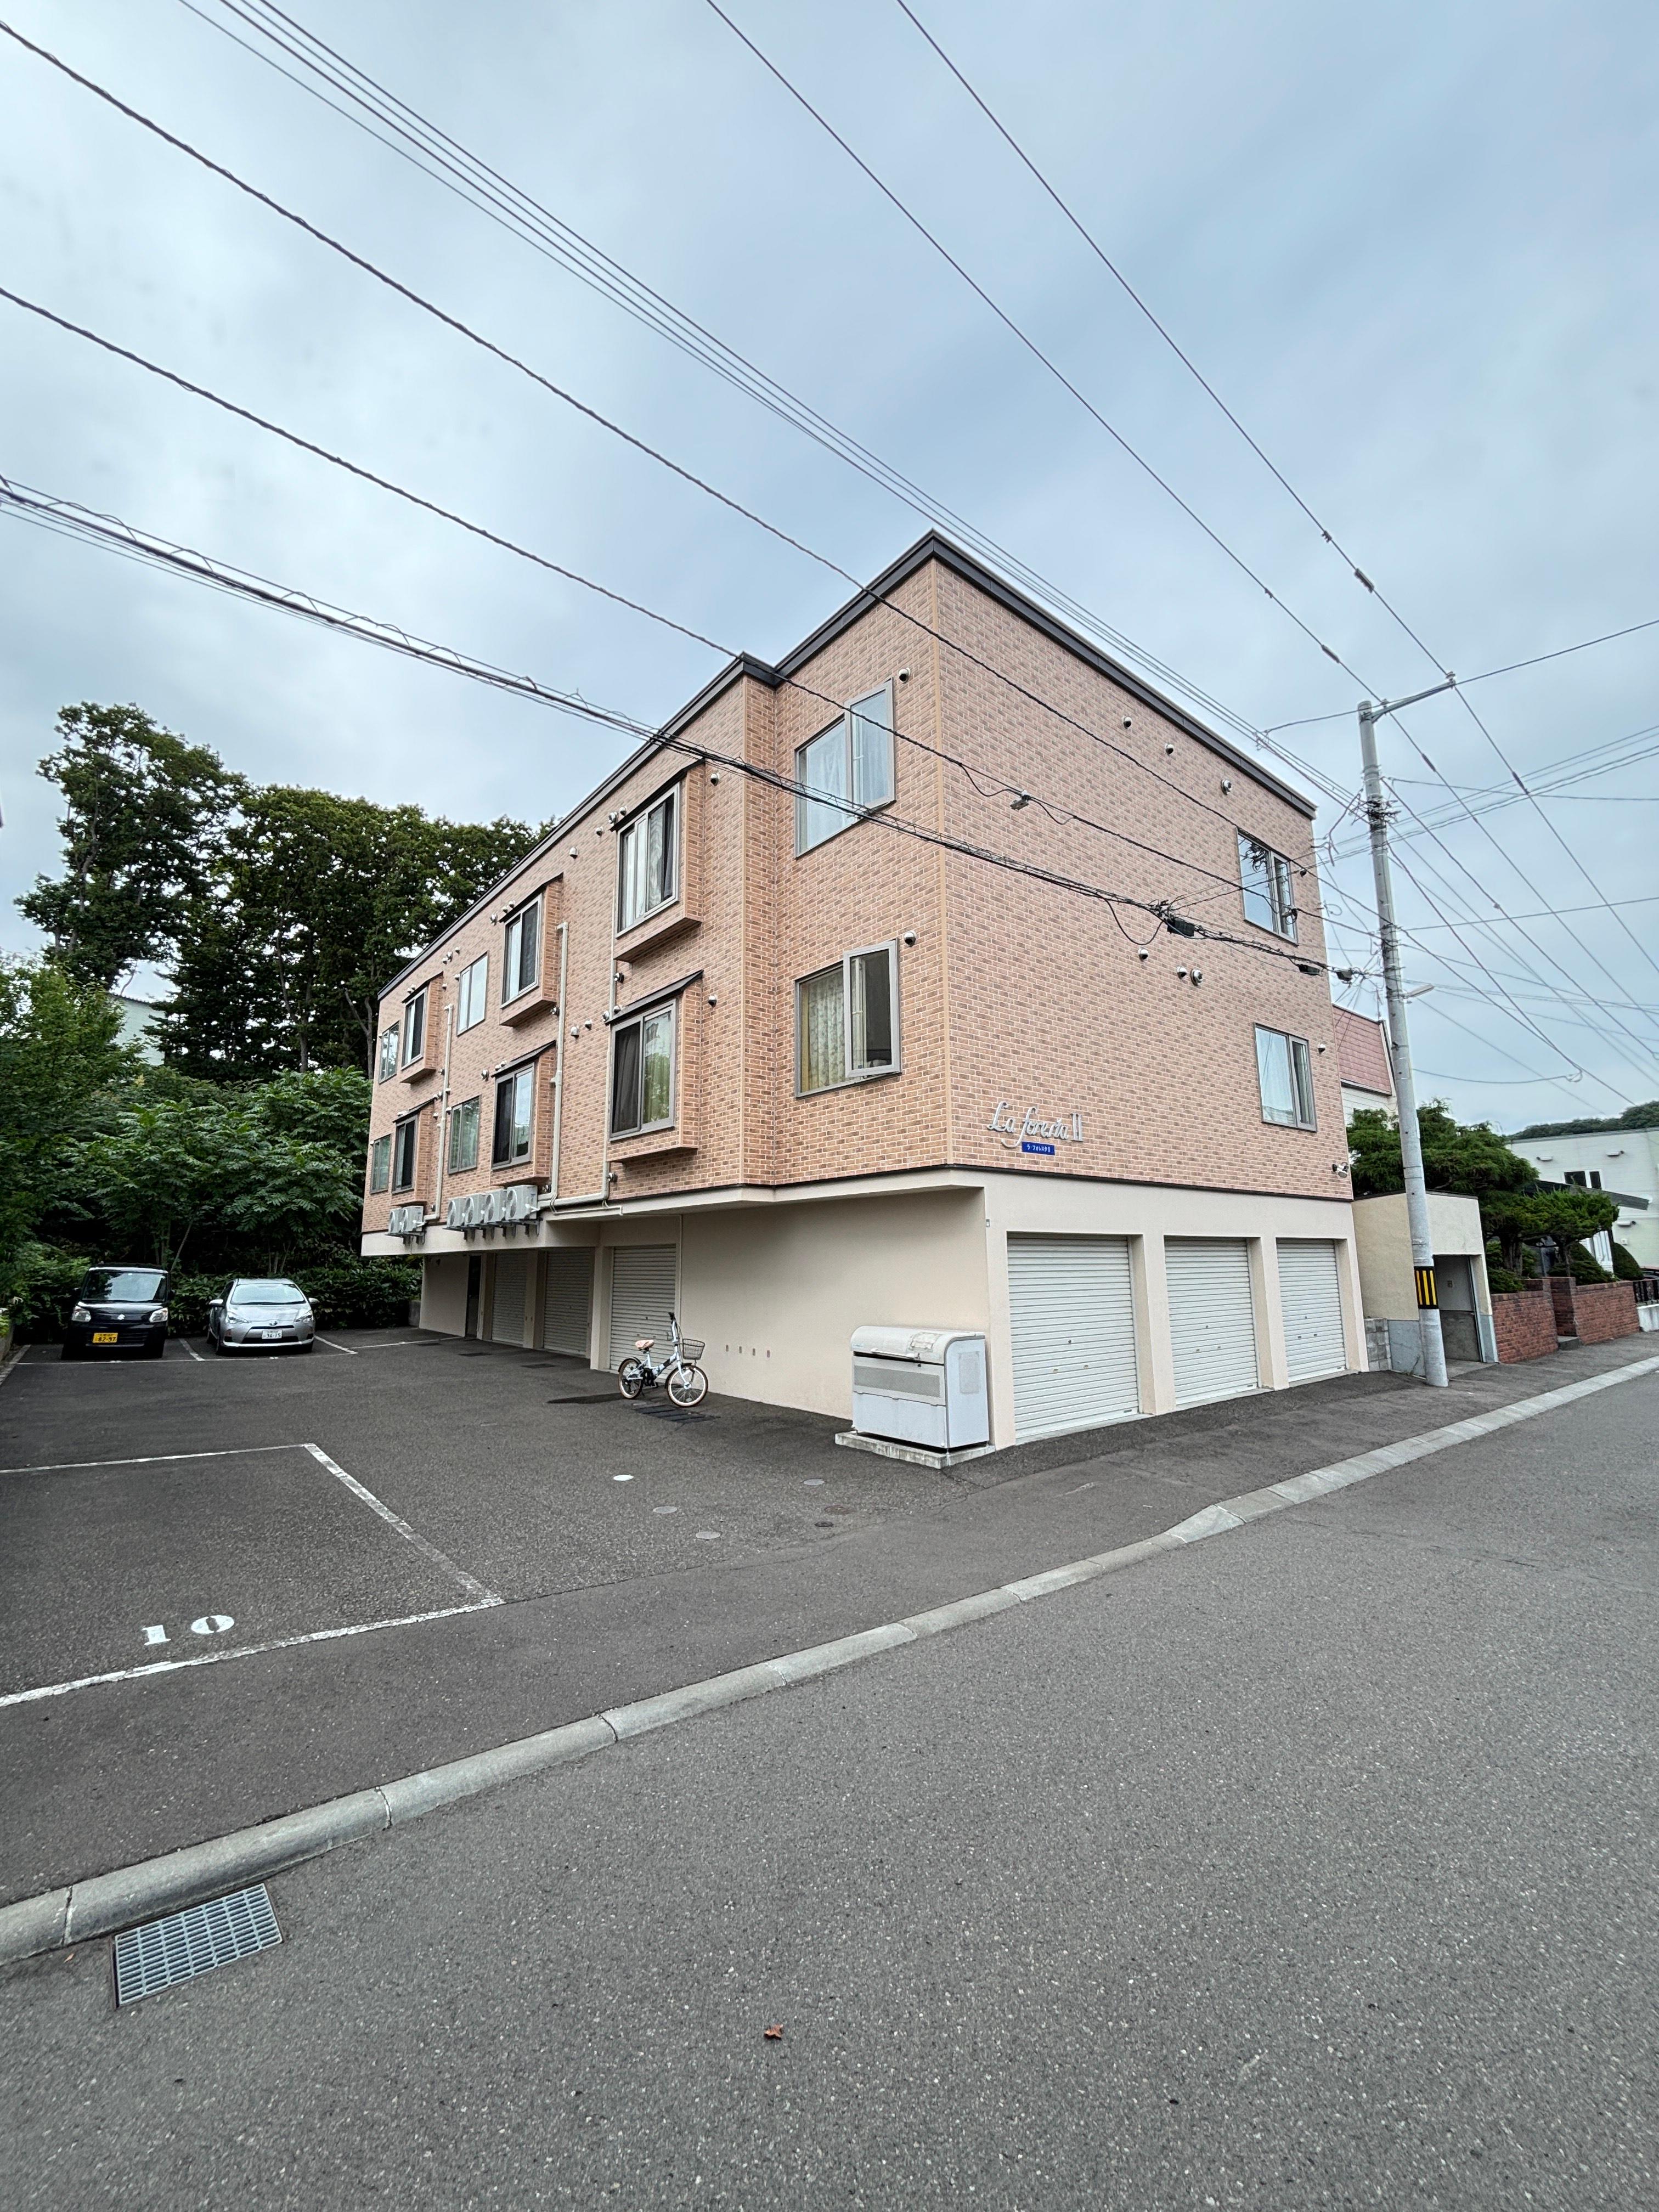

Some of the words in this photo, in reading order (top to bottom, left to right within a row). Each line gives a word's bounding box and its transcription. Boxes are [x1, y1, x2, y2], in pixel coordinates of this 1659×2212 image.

[988, 1101, 1016, 1133] La
[1001, 1106, 1069, 1148] foresta
[141, 1615, 235, 1645] 10
